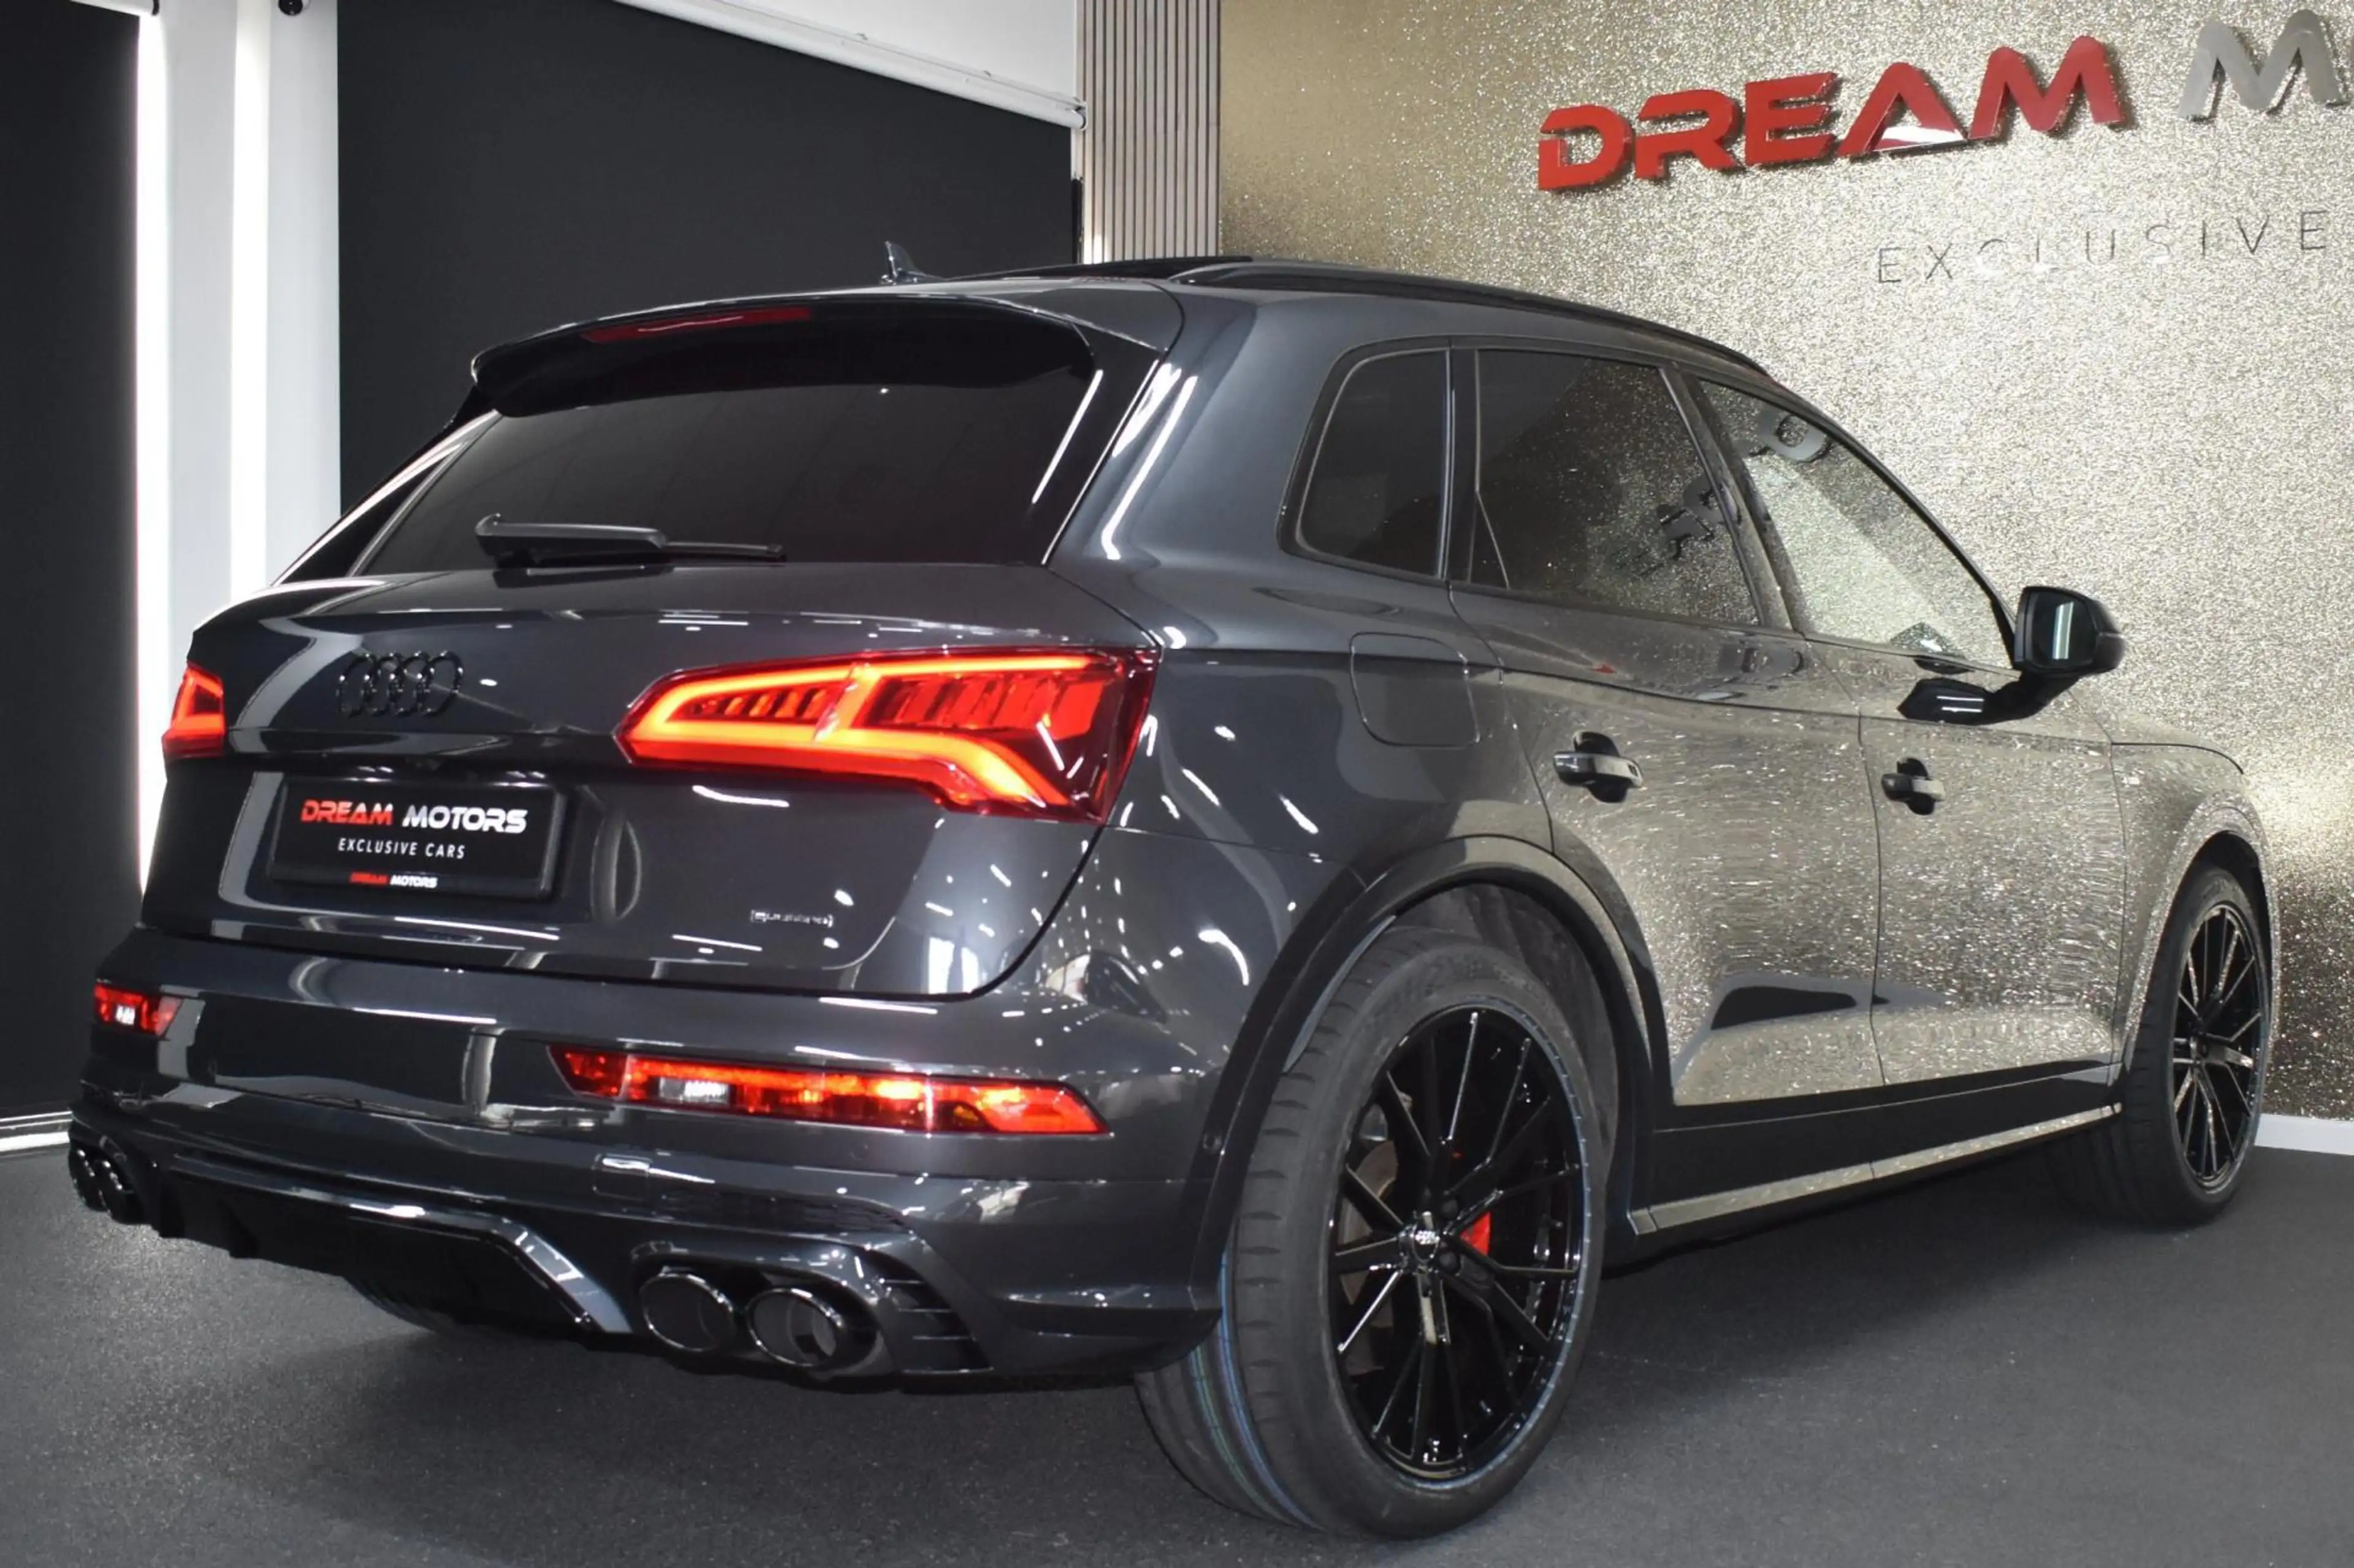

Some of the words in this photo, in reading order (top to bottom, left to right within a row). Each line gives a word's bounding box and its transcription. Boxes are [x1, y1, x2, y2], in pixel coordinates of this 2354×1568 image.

[1537, 34, 2122, 192] DREAM
[1878, 210, 2328, 284] EXCLUSIVE
[300, 799, 394, 826] DREAM
[402, 805, 528, 834] MOTORS
[338, 837, 418, 856] EXCLUSIVE
[425, 842, 465, 859] CARS
